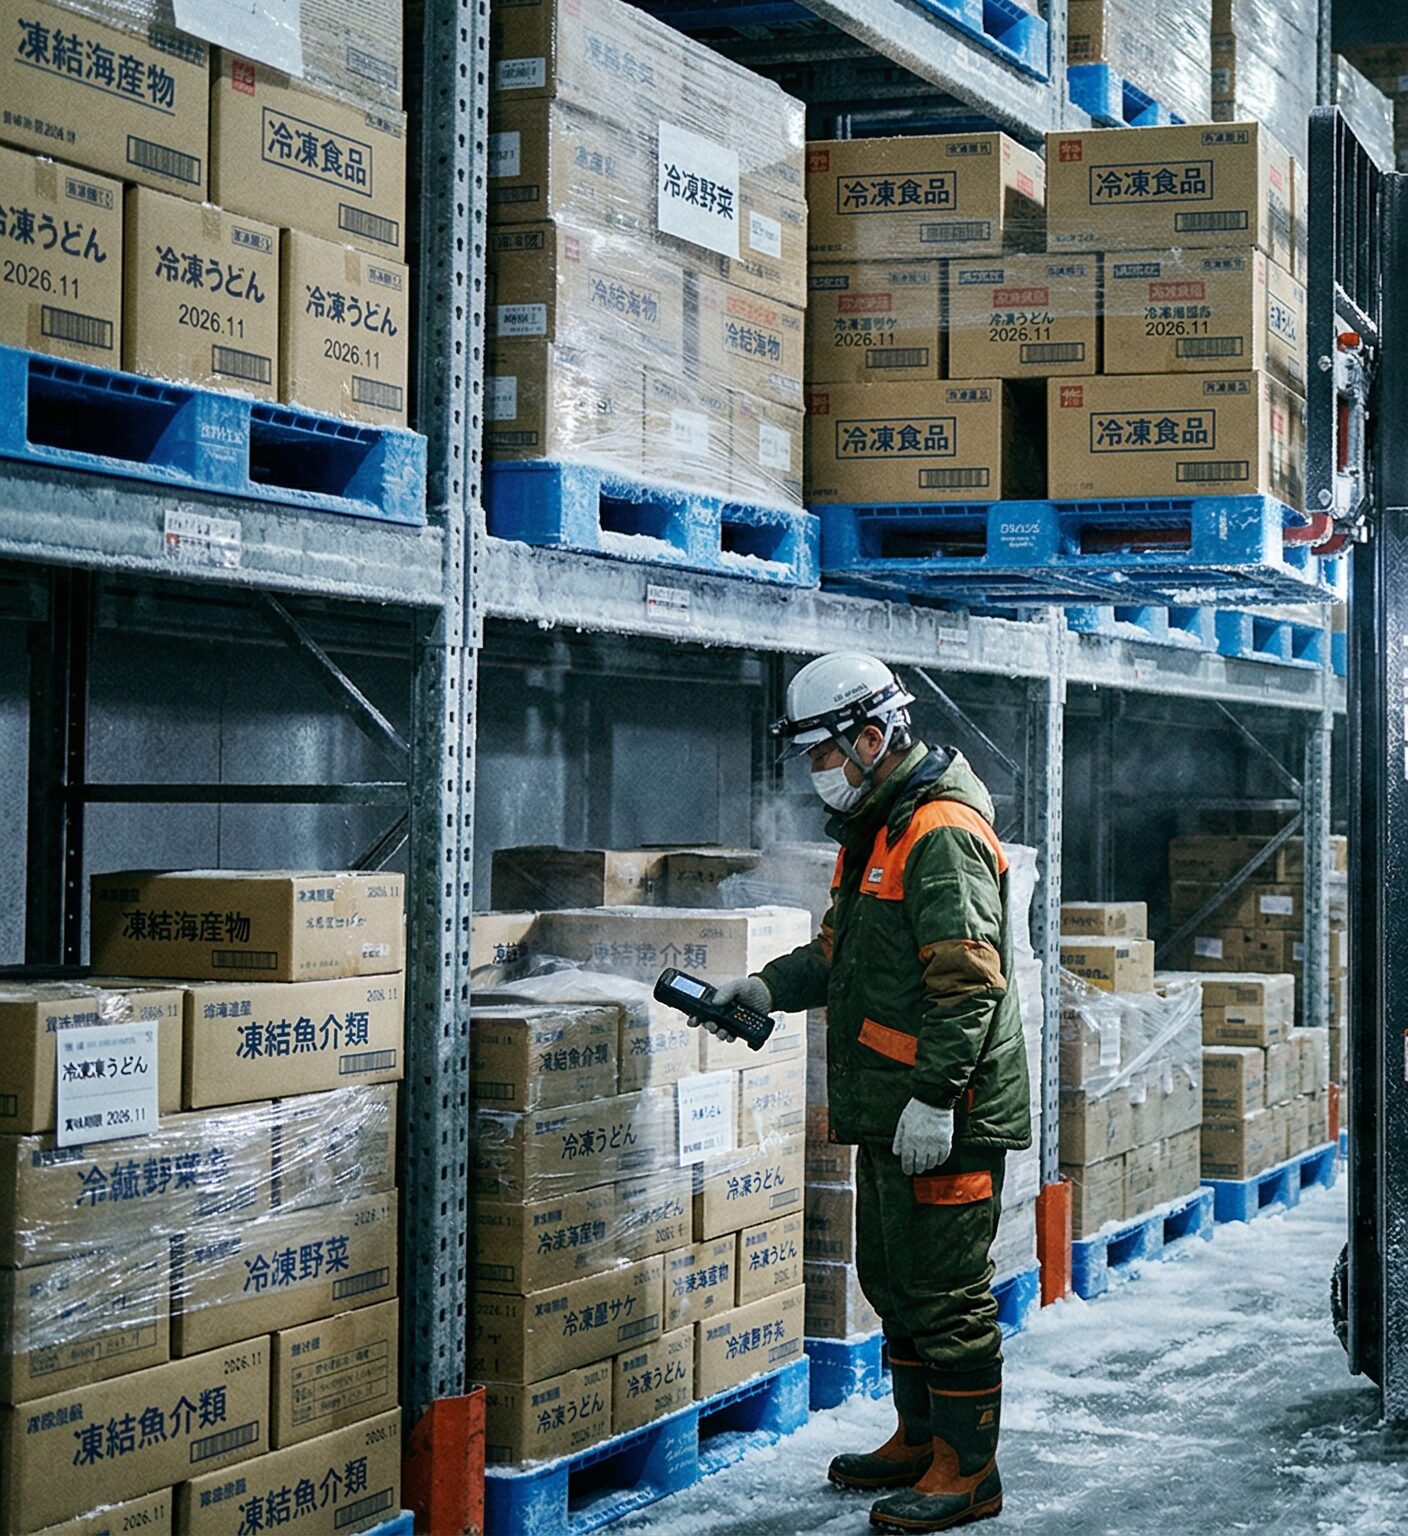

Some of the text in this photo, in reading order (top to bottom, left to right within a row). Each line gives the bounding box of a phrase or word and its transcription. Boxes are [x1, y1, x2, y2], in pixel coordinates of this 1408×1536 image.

[18, 18, 175, 108] 凍結海産物
[268, 119, 367, 187] 冷凍食品
[664, 163, 735, 220] 冷凍野菜
[843, 178, 949, 208] 冷凍食品
[1095, 167, 1206, 198] 冷凍食品
[0, 204, 107, 263] 凍うどん
[3, 260, 79, 300] 2026.11
[155, 245, 265, 304] 冷凍うどん
[178, 303, 245, 339] 2026.11
[305, 284, 398, 338] 冷凍うどん
[1145, 320, 1209, 336] 2026.11
[833, 332, 895, 347] 2026.11
[988, 327, 1051, 342] 2026.11
[323, 338, 381, 370] 2026.11
[841, 424, 949, 453] 冷凍食品
[1096, 417, 1209, 447] 冷凍食品
[122, 909, 251, 944] 凍結海産物
[236, 1011, 370, 1060] 凍結魚介類
[72, 1384, 228, 1468] 凍結魚介類
[237, 1455, 369, 1536] 凍結魚介類
